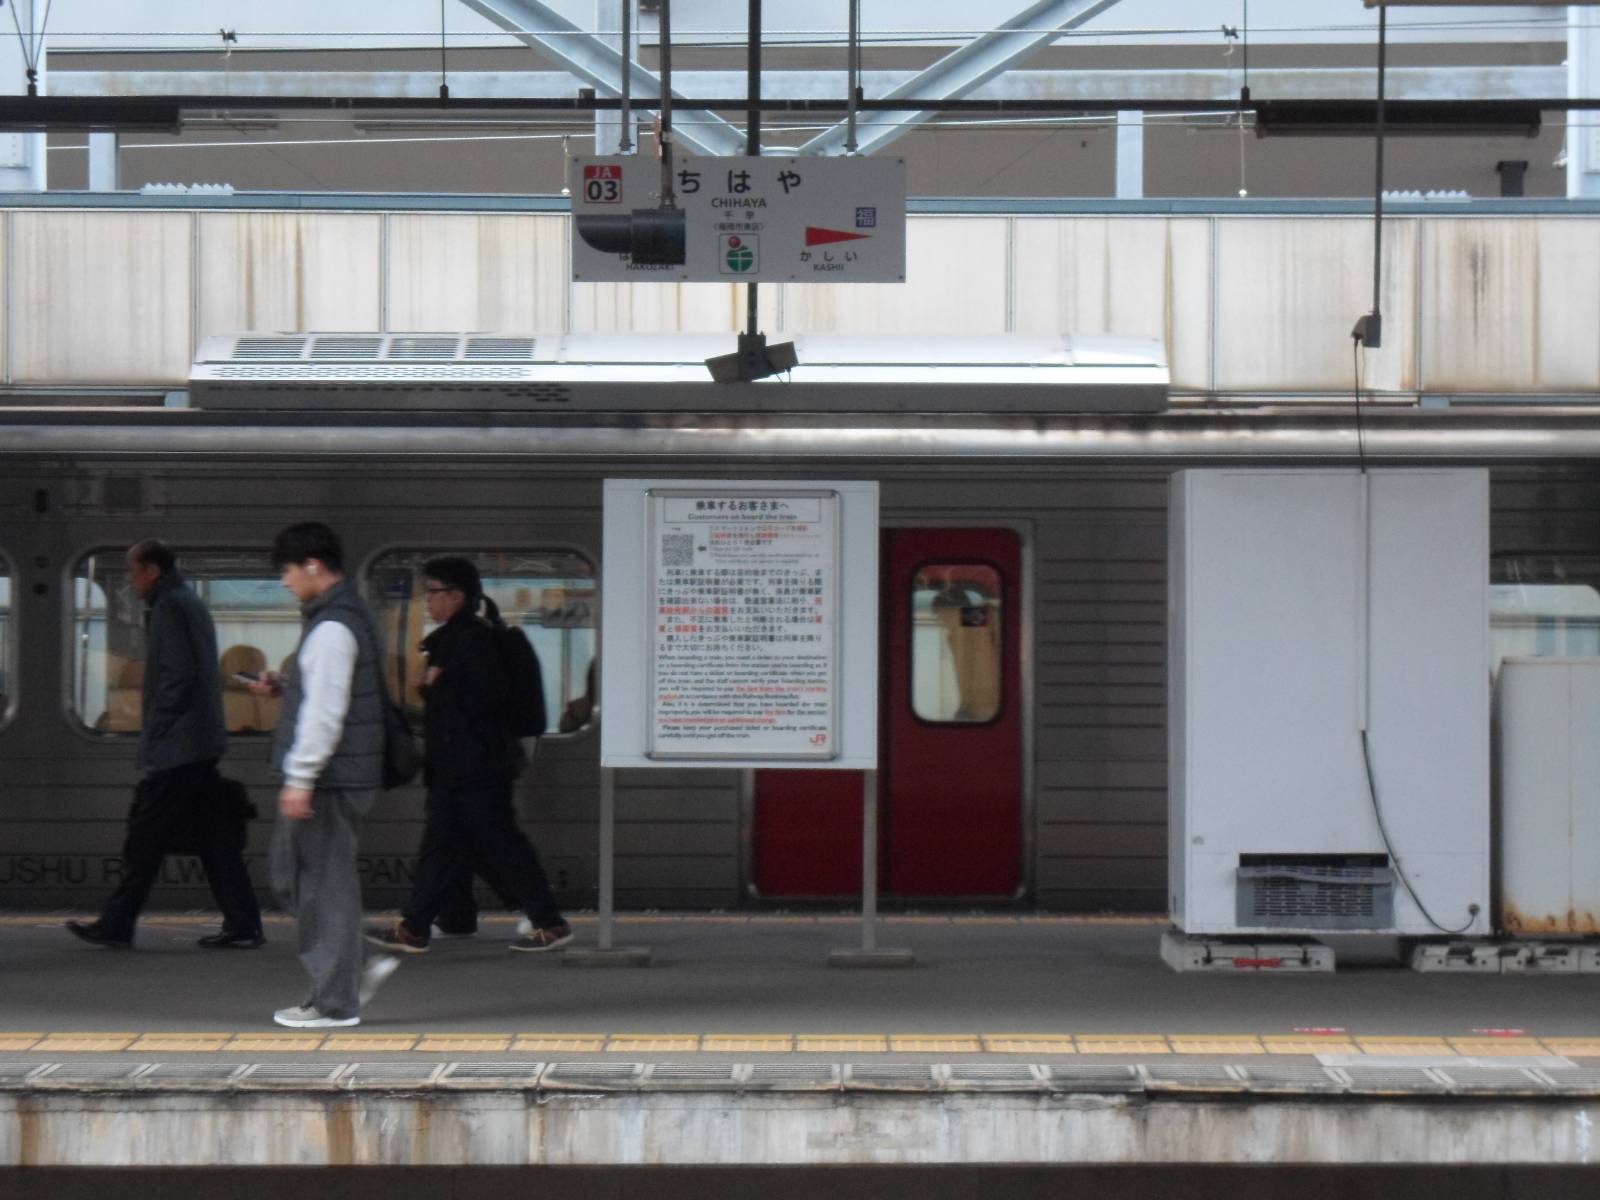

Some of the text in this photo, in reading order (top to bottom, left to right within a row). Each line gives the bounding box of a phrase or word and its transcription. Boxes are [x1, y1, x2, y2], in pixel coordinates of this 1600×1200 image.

[594, 167, 611, 178] JA
[677, 169, 801, 194] ちはや
[587, 181, 619, 201] 03
[711, 198, 767, 208] CHIHAYA
[857, 208, 875, 226] 福
[800, 251, 858, 262] かしい
[813, 263, 844, 272] KASHII
[810, 734, 826, 743] JR
